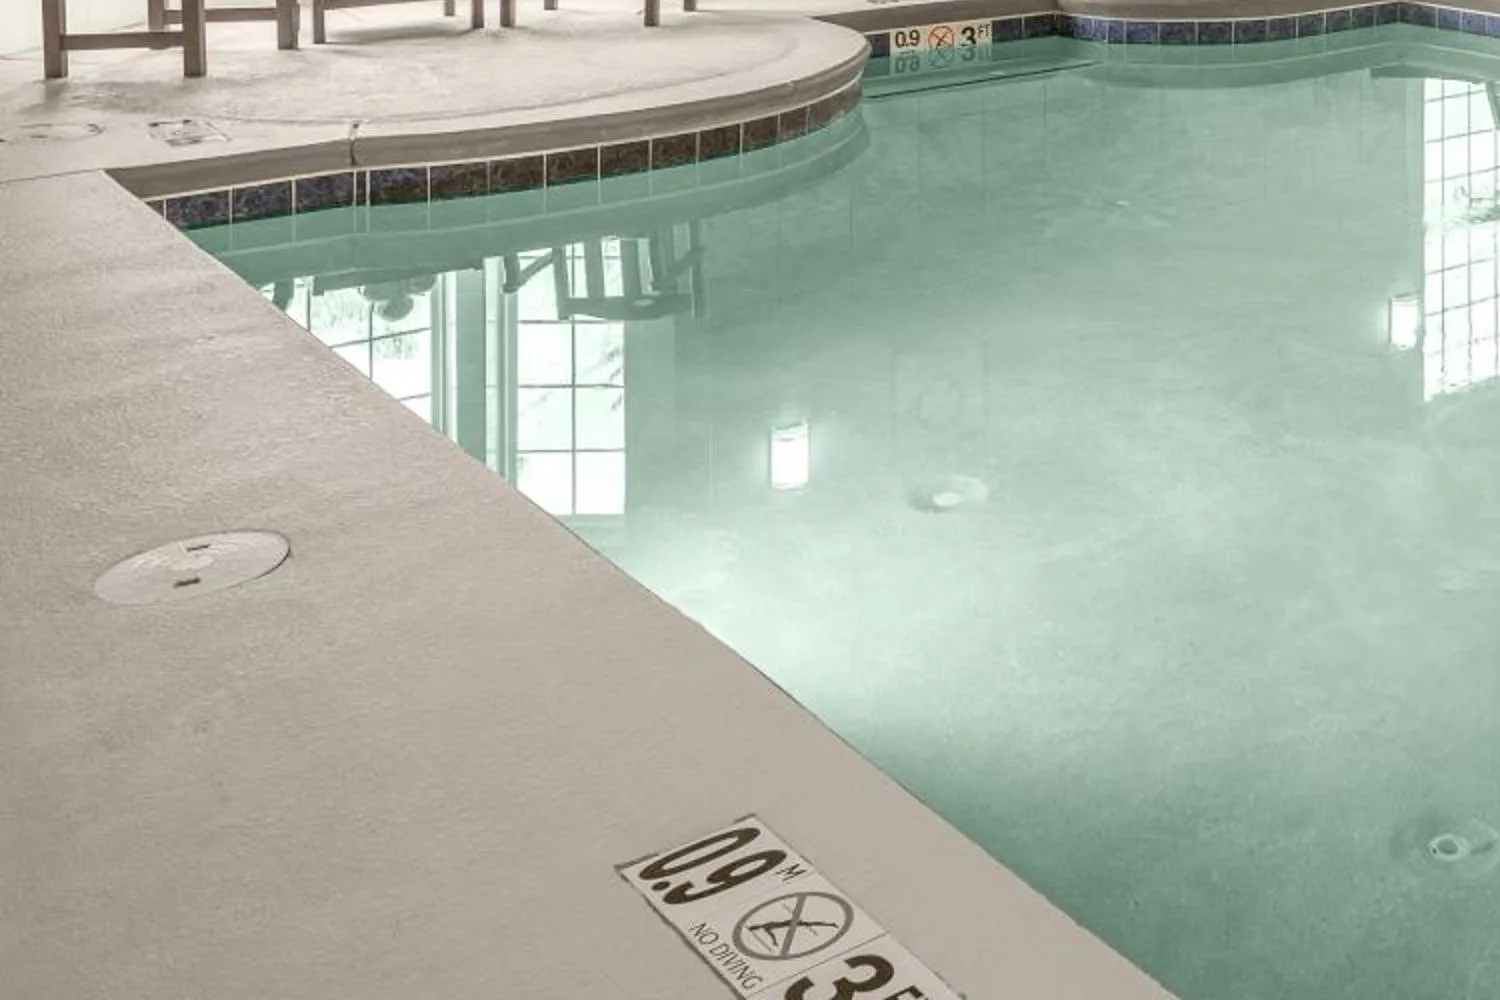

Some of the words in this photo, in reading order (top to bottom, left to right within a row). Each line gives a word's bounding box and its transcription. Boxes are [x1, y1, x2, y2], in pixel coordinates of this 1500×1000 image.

[895, 30, 921, 49] 0.9
[638, 827, 788, 905] 0.9
[688, 922, 720, 945] NO
[708, 943, 765, 990] DIVING
